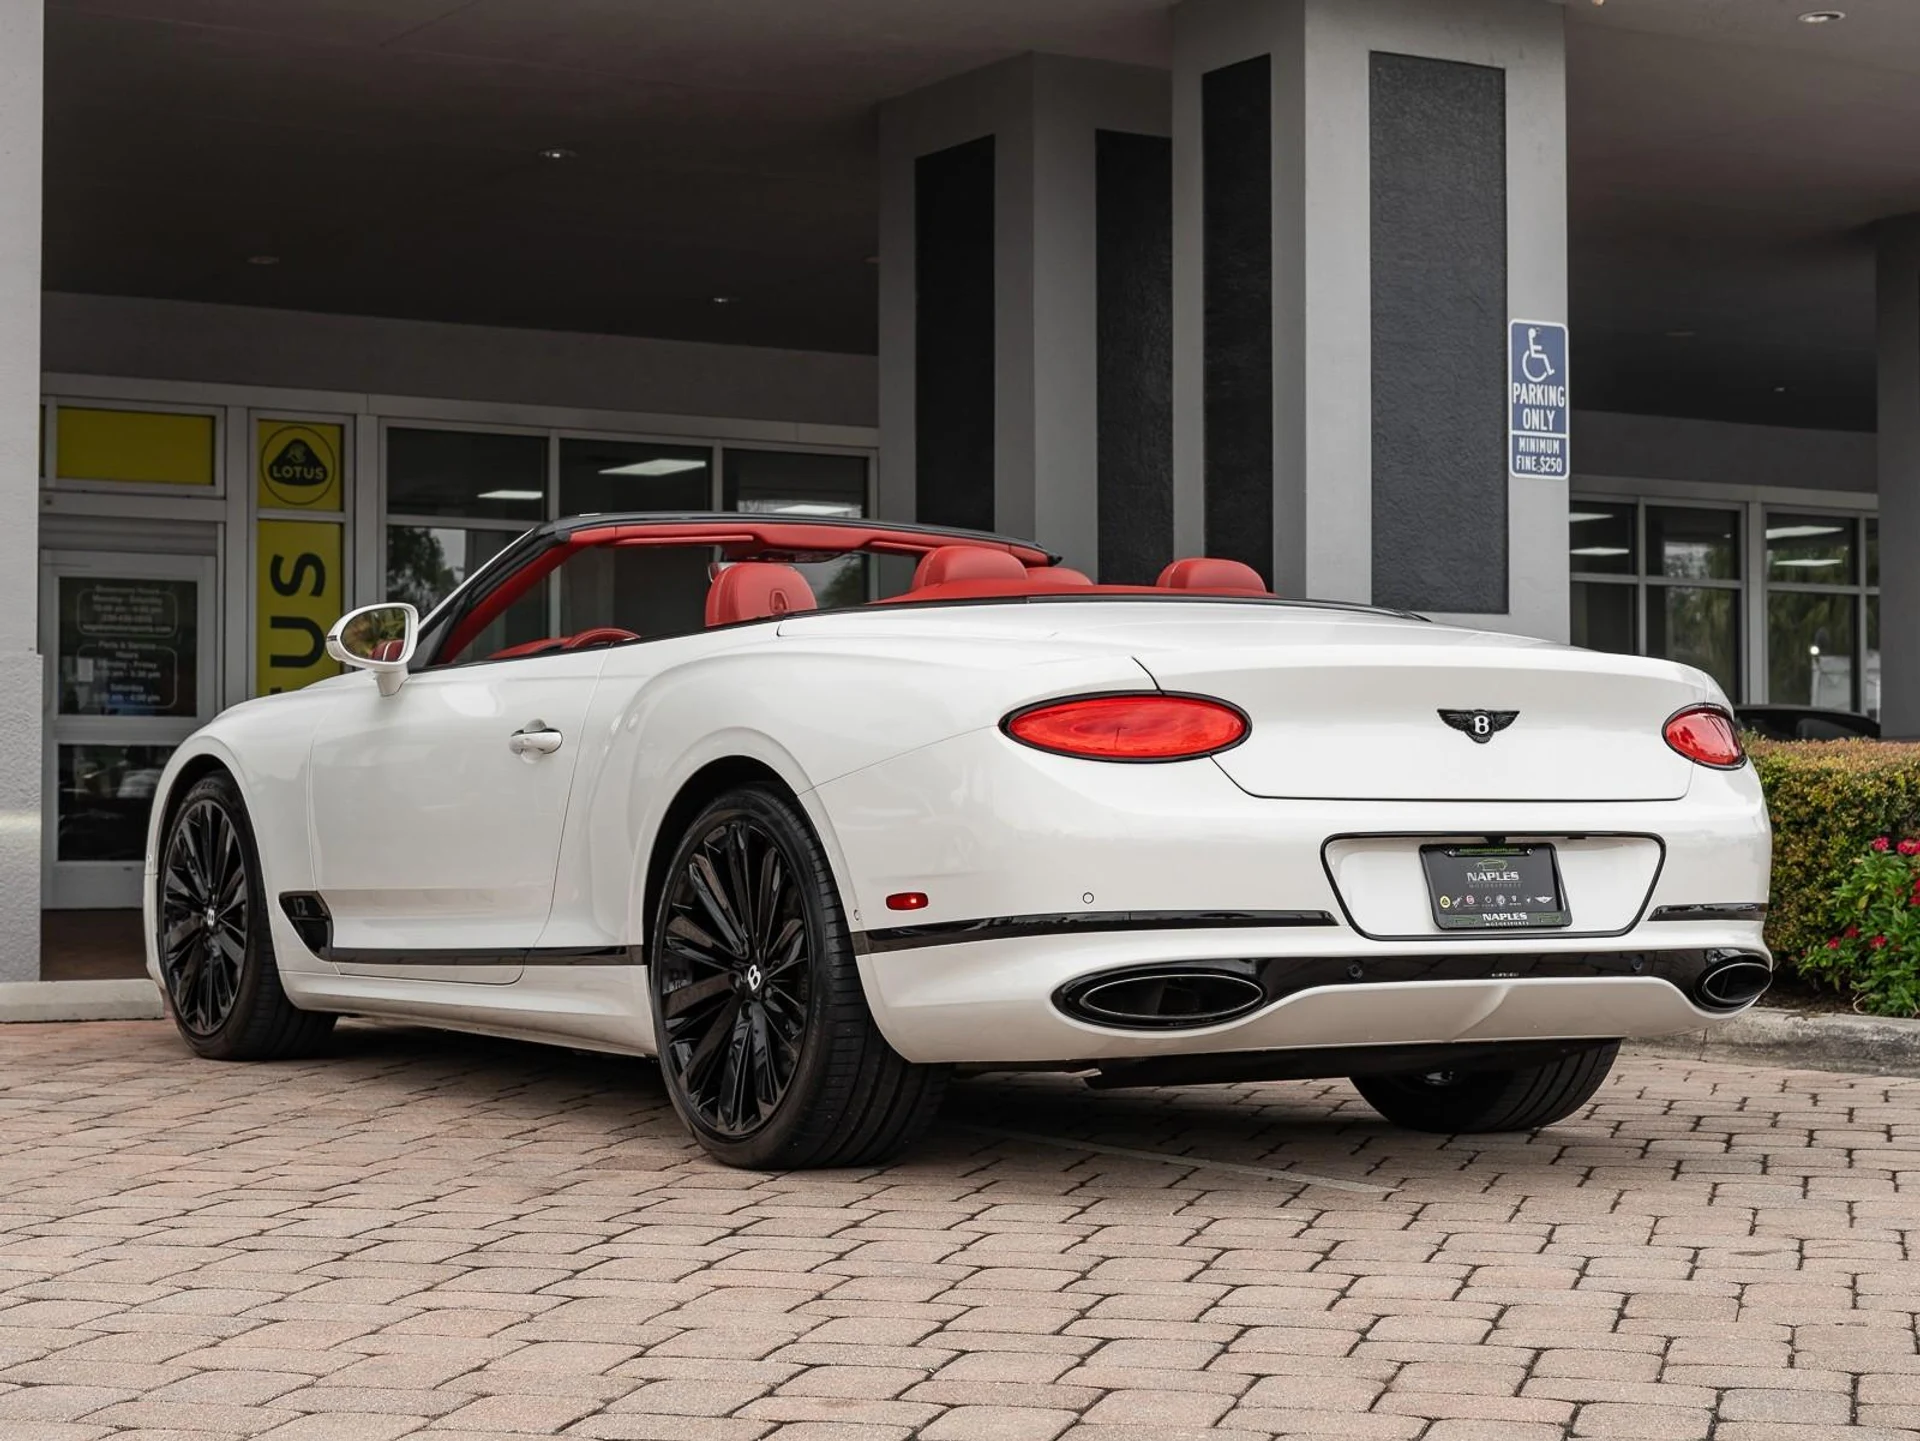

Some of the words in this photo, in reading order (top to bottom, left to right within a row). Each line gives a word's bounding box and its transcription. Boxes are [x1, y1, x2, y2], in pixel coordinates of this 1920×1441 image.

[1513, 382, 1565, 407] PARKING
[1522, 408, 1556, 431] ONLY
[1518, 436, 1560, 454] MINIMUM
[272, 465, 325, 480] LOTUS
[1516, 455, 1537, 471] FINE
[1539, 455, 1563, 473] $250
[269, 552, 326, 695] US
[1474, 715, 1490, 734] B
[1466, 871, 1520, 881] NAPLES
[1482, 912, 1528, 921] NAPLES
